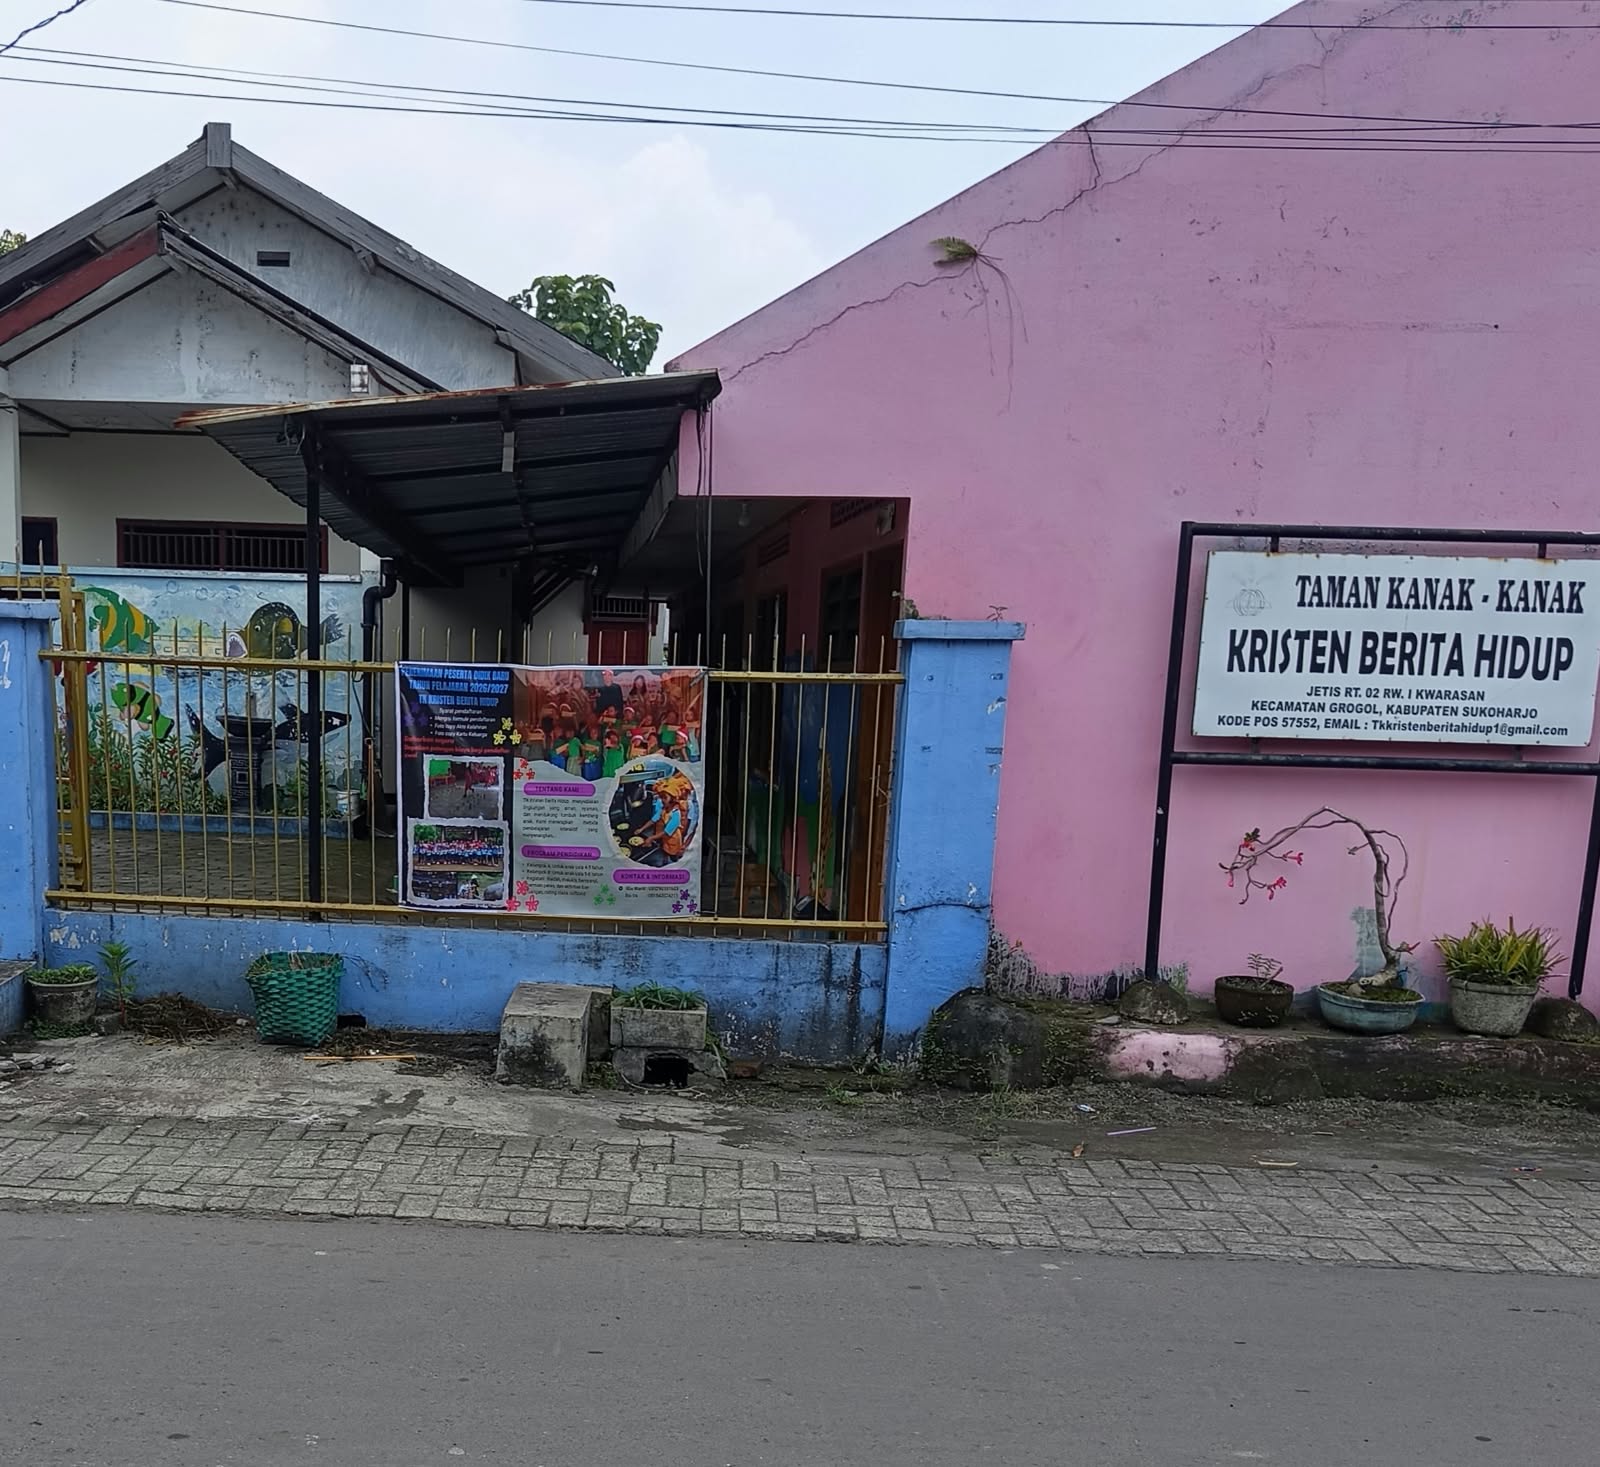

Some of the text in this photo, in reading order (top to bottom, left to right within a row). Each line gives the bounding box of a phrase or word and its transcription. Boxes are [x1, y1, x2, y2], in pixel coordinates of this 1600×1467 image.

[1296, 575, 1381, 608] TAMAN
[1386, 577, 1475, 611] KANAK
[1496, 580, 1586, 614] KANAK
[1227, 628, 1574, 681] KRISTEN BERITA HIDUP
[444, 669, 472, 679] PESERTA
[410, 680, 508, 694] TAHUN PELAJARAN 2026/2027
[1306, 686, 1340, 697] JETIS
[1344, 687, 1362, 697] RT.
[1366, 688, 1379, 698] 02
[1383, 688, 1404, 699] RW.
[1416, 689, 1485, 701] KWARASAN
[419, 694, 427, 704] TK
[428, 695, 454, 705] KRISTEN
[456, 696, 478, 706] BERITA
[1251, 700, 1538, 719] KECAMATAN GROGOL, KABUPATEN SUKOHARJO
[1217, 715, 1250, 726] KODE
[1254, 716, 1278, 727] POS
[1282, 717, 1320, 730] 57552,
[1324, 718, 1361, 730] EMAIL
[1372, 720, 1568, 736] Tkkristenberitahidup1@gmail.com
